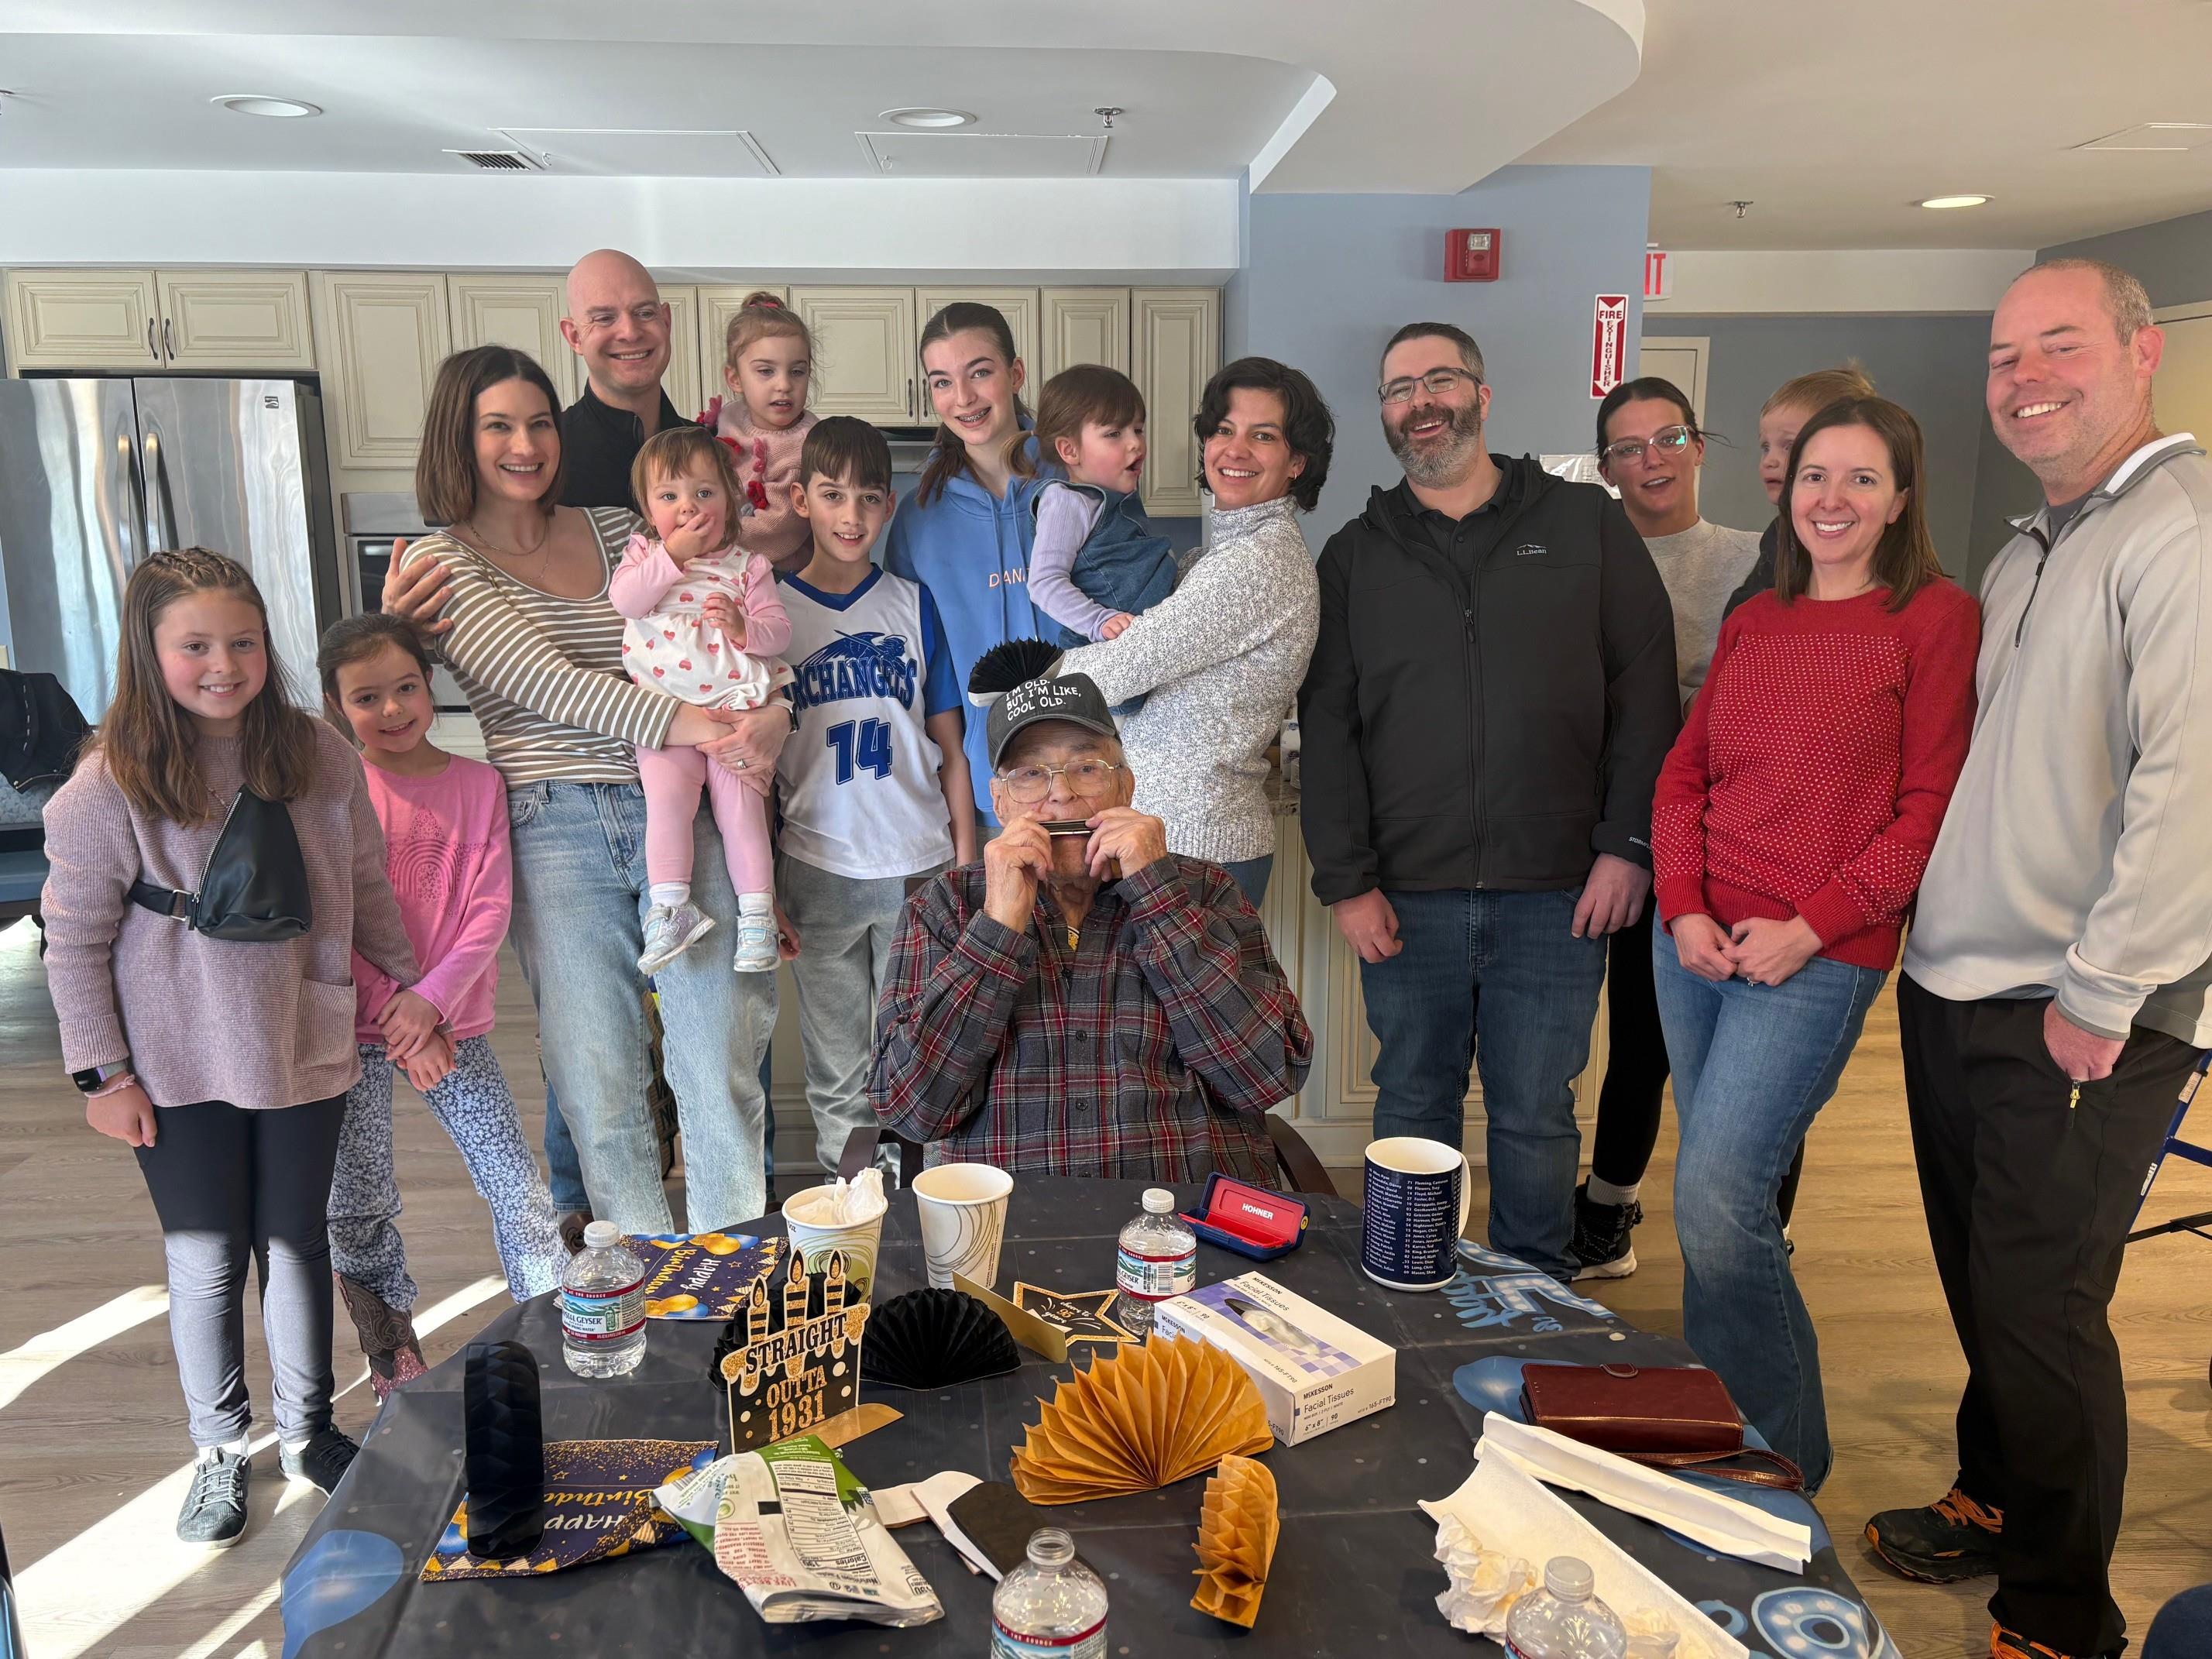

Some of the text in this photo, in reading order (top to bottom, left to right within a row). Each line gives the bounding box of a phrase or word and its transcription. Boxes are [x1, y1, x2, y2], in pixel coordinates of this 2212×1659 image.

[1644, 253, 1666, 295] IT
[1599, 311, 1623, 319] FIRE
[1602, 321, 1613, 386] EXTINGUISHER
[1006, 679, 1050, 701] I'M OLD.
[1006, 685, 1081, 710] BUT I'M LIKE,
[1008, 696, 1066, 721] COOL OLD.
[826, 717, 892, 785] 14
[1242, 1203, 1274, 1220] HOHNER
[1121, 1270, 1139, 1284] GEYSER
[1239, 1280, 1264, 1295] Facial
[1262, 1291, 1290, 1311] Tissues
[576, 1317, 603, 1325] GEYSER
[746, 1313, 847, 1375] STRAIGHT
[766, 1365, 827, 1409] OUTTA
[1304, 1388, 1354, 1413] Facial Tissues
[768, 1389, 826, 1442] 1931
[544, 1513, 626, 1530] HAPP
[836, 1554, 867, 1566] Calories
[1026, 1637, 1053, 1647] SOURCE
